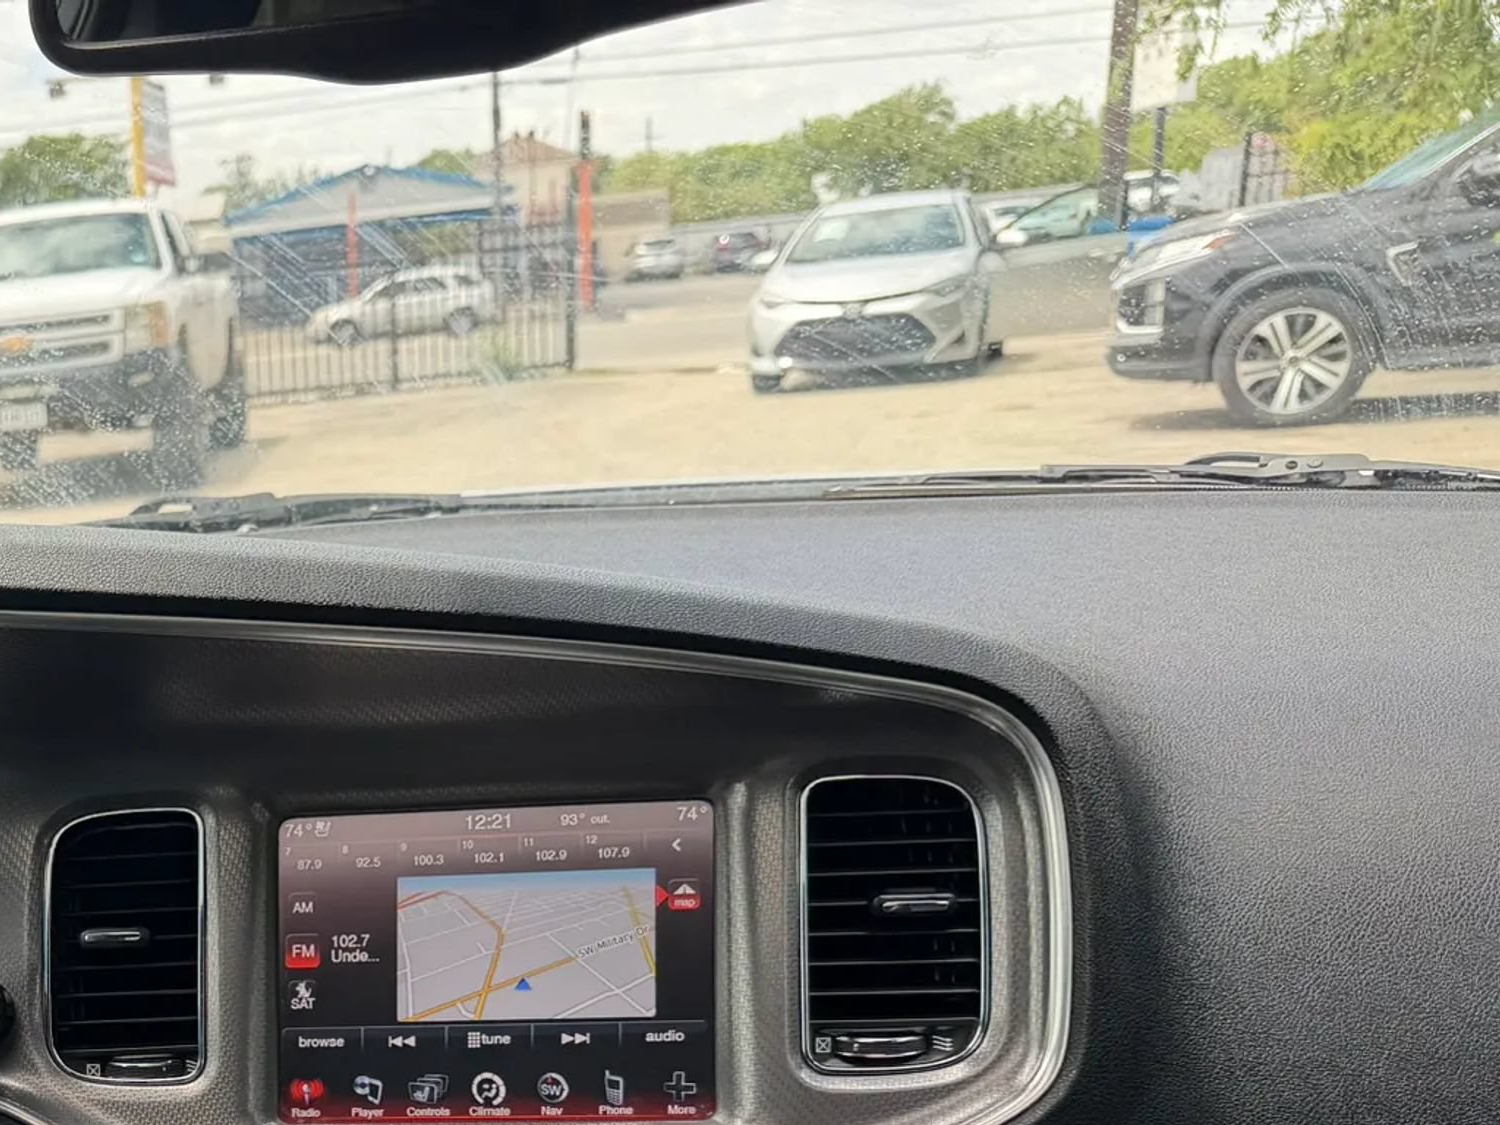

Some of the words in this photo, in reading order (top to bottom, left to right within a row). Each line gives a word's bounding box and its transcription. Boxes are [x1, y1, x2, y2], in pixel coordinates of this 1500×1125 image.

[465, 814, 512, 831] 12:21
[560, 812, 585, 827] 93°
[590, 814, 611, 825] out.
[462, 840, 474, 850] 10
[524, 837, 534, 847] 11
[586, 835, 598, 845] 12
[473, 851, 505, 864] 102.1
[535, 849, 567, 862] 102.9
[597, 846, 630, 859] 107.9
[297, 859, 322, 871] 87.9
[355, 857, 381, 868] 92.5
[413, 854, 445, 866] 100.3
[292, 901, 314, 914] AM
[331, 934, 370, 948] 102.7
[597, 932, 635, 950] Military
[291, 944, 315, 958] FM
[331, 949, 380, 963] Unde...
[290, 998, 316, 1010] SAT
[298, 1036, 345, 1048] browse
[481, 1034, 511, 1045] tune
[645, 1030, 685, 1042] audio
[540, 1083, 563, 1096] SW
[291, 1107, 321, 1118] Radio
[351, 1107, 385, 1120] Player
[406, 1106, 450, 1117] Controls
[469, 1105, 511, 1117] Climate
[541, 1105, 563, 1116] Nav
[599, 1104, 634, 1116] Phone
[667, 1104, 696, 1115] More
